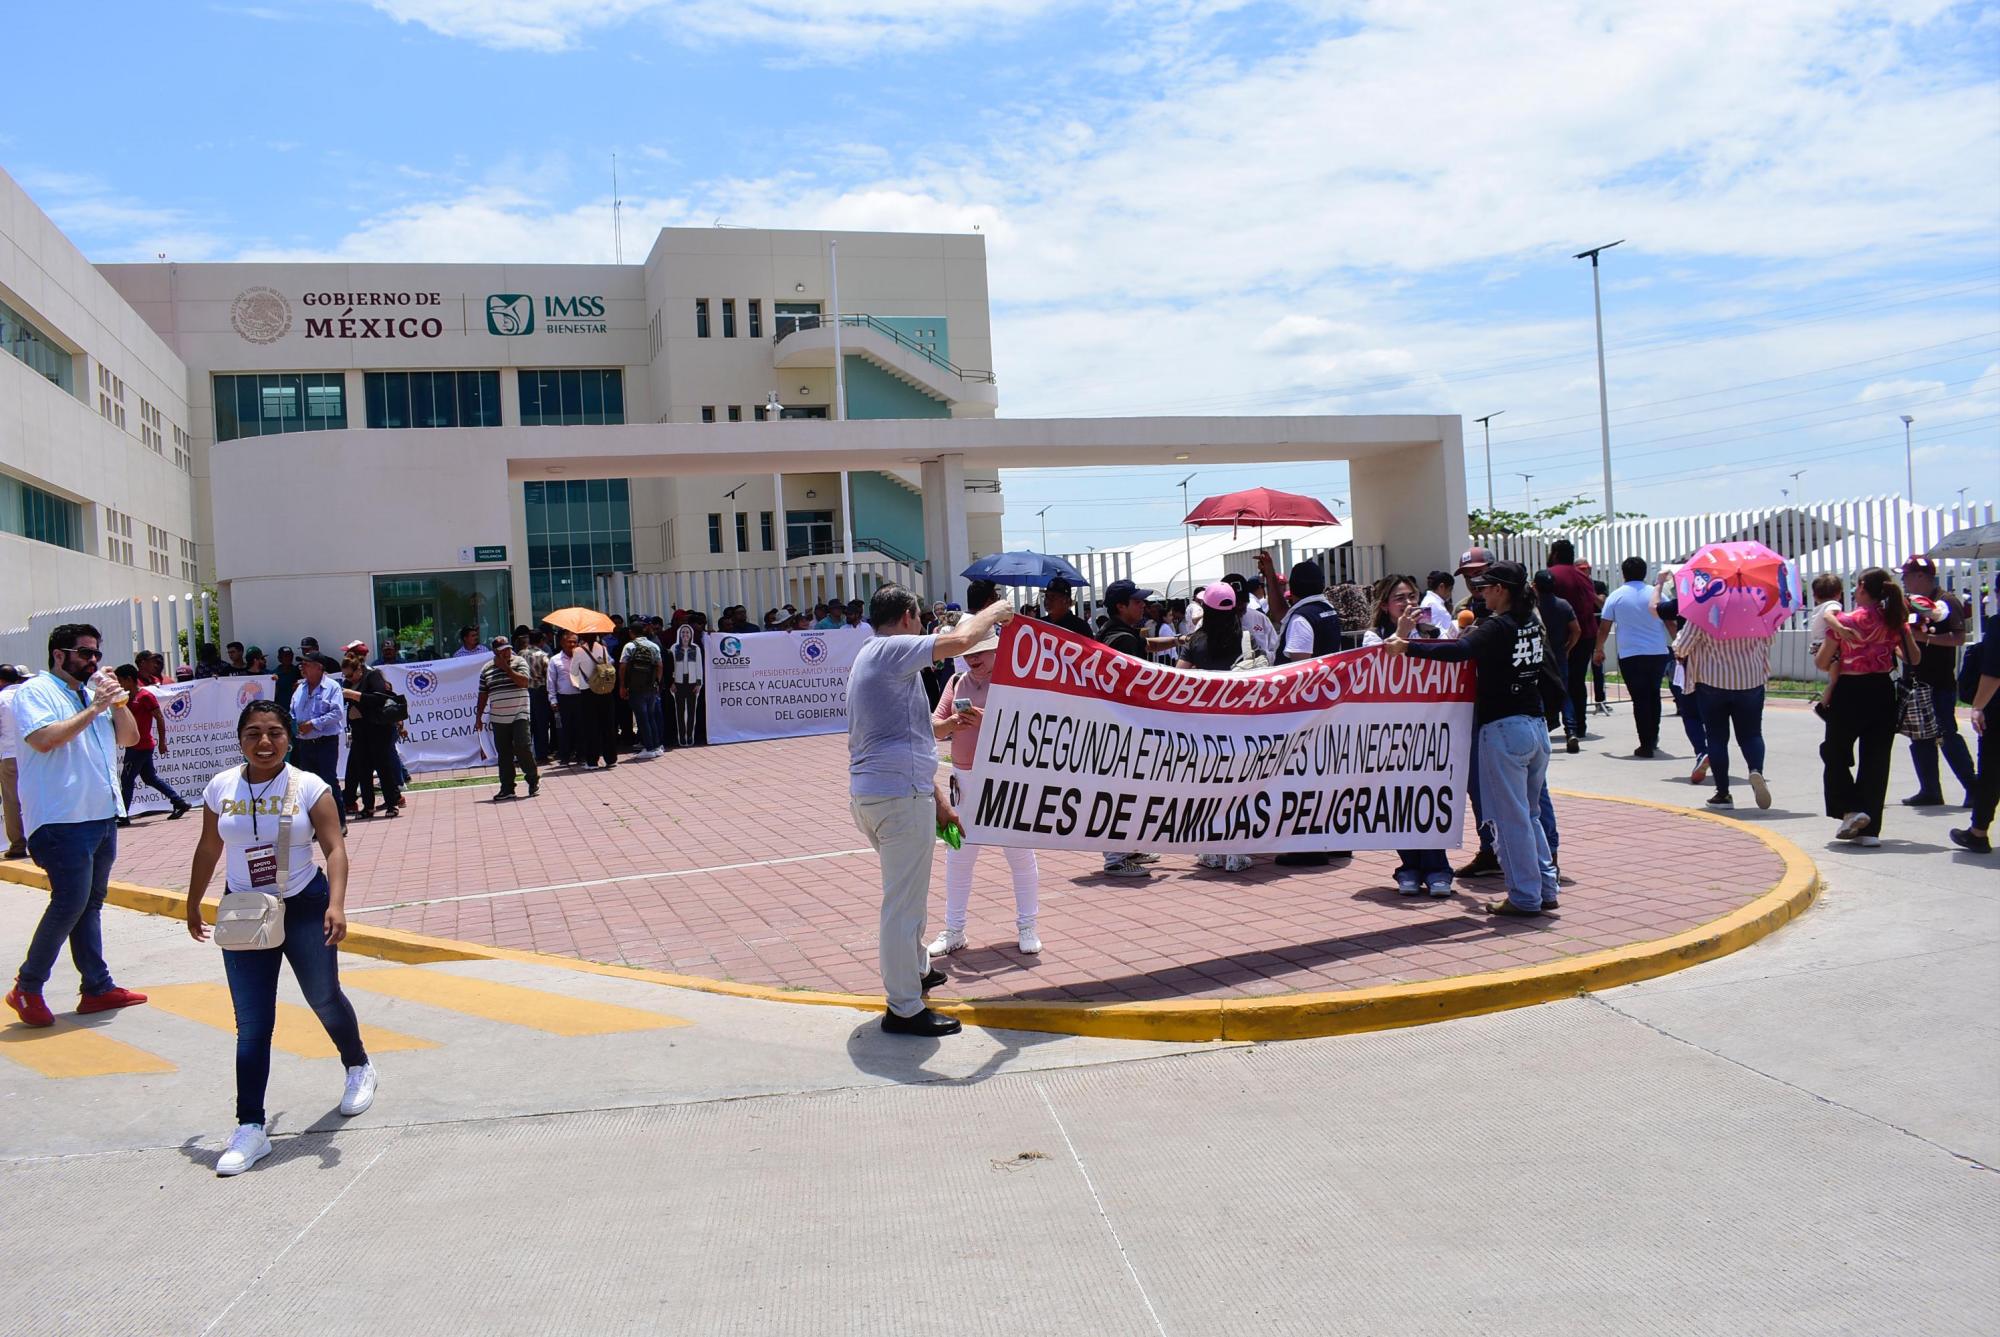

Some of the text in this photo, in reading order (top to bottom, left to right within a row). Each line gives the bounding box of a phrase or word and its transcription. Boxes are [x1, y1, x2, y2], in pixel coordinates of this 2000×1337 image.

[303, 292, 411, 306] GOBIERNO
[415, 292, 441, 306] DE
[545, 295, 605, 317] IMSS
[304, 307, 443, 338] MÉXICO
[546, 324, 607, 334] BIENESTAR
[712, 657, 751, 665] COADES
[1011, 624, 1128, 694] OBRAS
[1279, 662, 1346, 704] NOS
[801, 666, 823, 676] AMLO
[758, 681, 765, 690] Y
[767, 677, 844, 690] ACUACULTURA
[411, 693, 478, 707] AMLO Y SHEIMBA
[720, 697, 743, 707] POR
[745, 693, 828, 706] CONTRABANDO
[830, 693, 837, 702] Y
[408, 713, 424, 725] LA
[775, 710, 794, 721] DEL
[186, 723, 192, 731] Y
[176, 735, 201, 744] PESCA
[203, 733, 209, 742] Y
[211, 731, 238, 741] ACUACUL
[421, 730, 438, 742] DE
[173, 747, 212, 759] EMPLEOS,
[988, 709, 1020, 765] LA
[1022, 712, 1133, 779] SEGUNDA
[1132, 728, 1199, 783] ETAPA
[1198, 734, 1236, 784] DEL
[1284, 728, 1314, 776] ES
[1314, 724, 1351, 776] UNA
[1353, 722, 1454, 781] NECESIDAD,
[974, 778, 1454, 842] MILES DE FAMILIAS PELIGRAMOS
